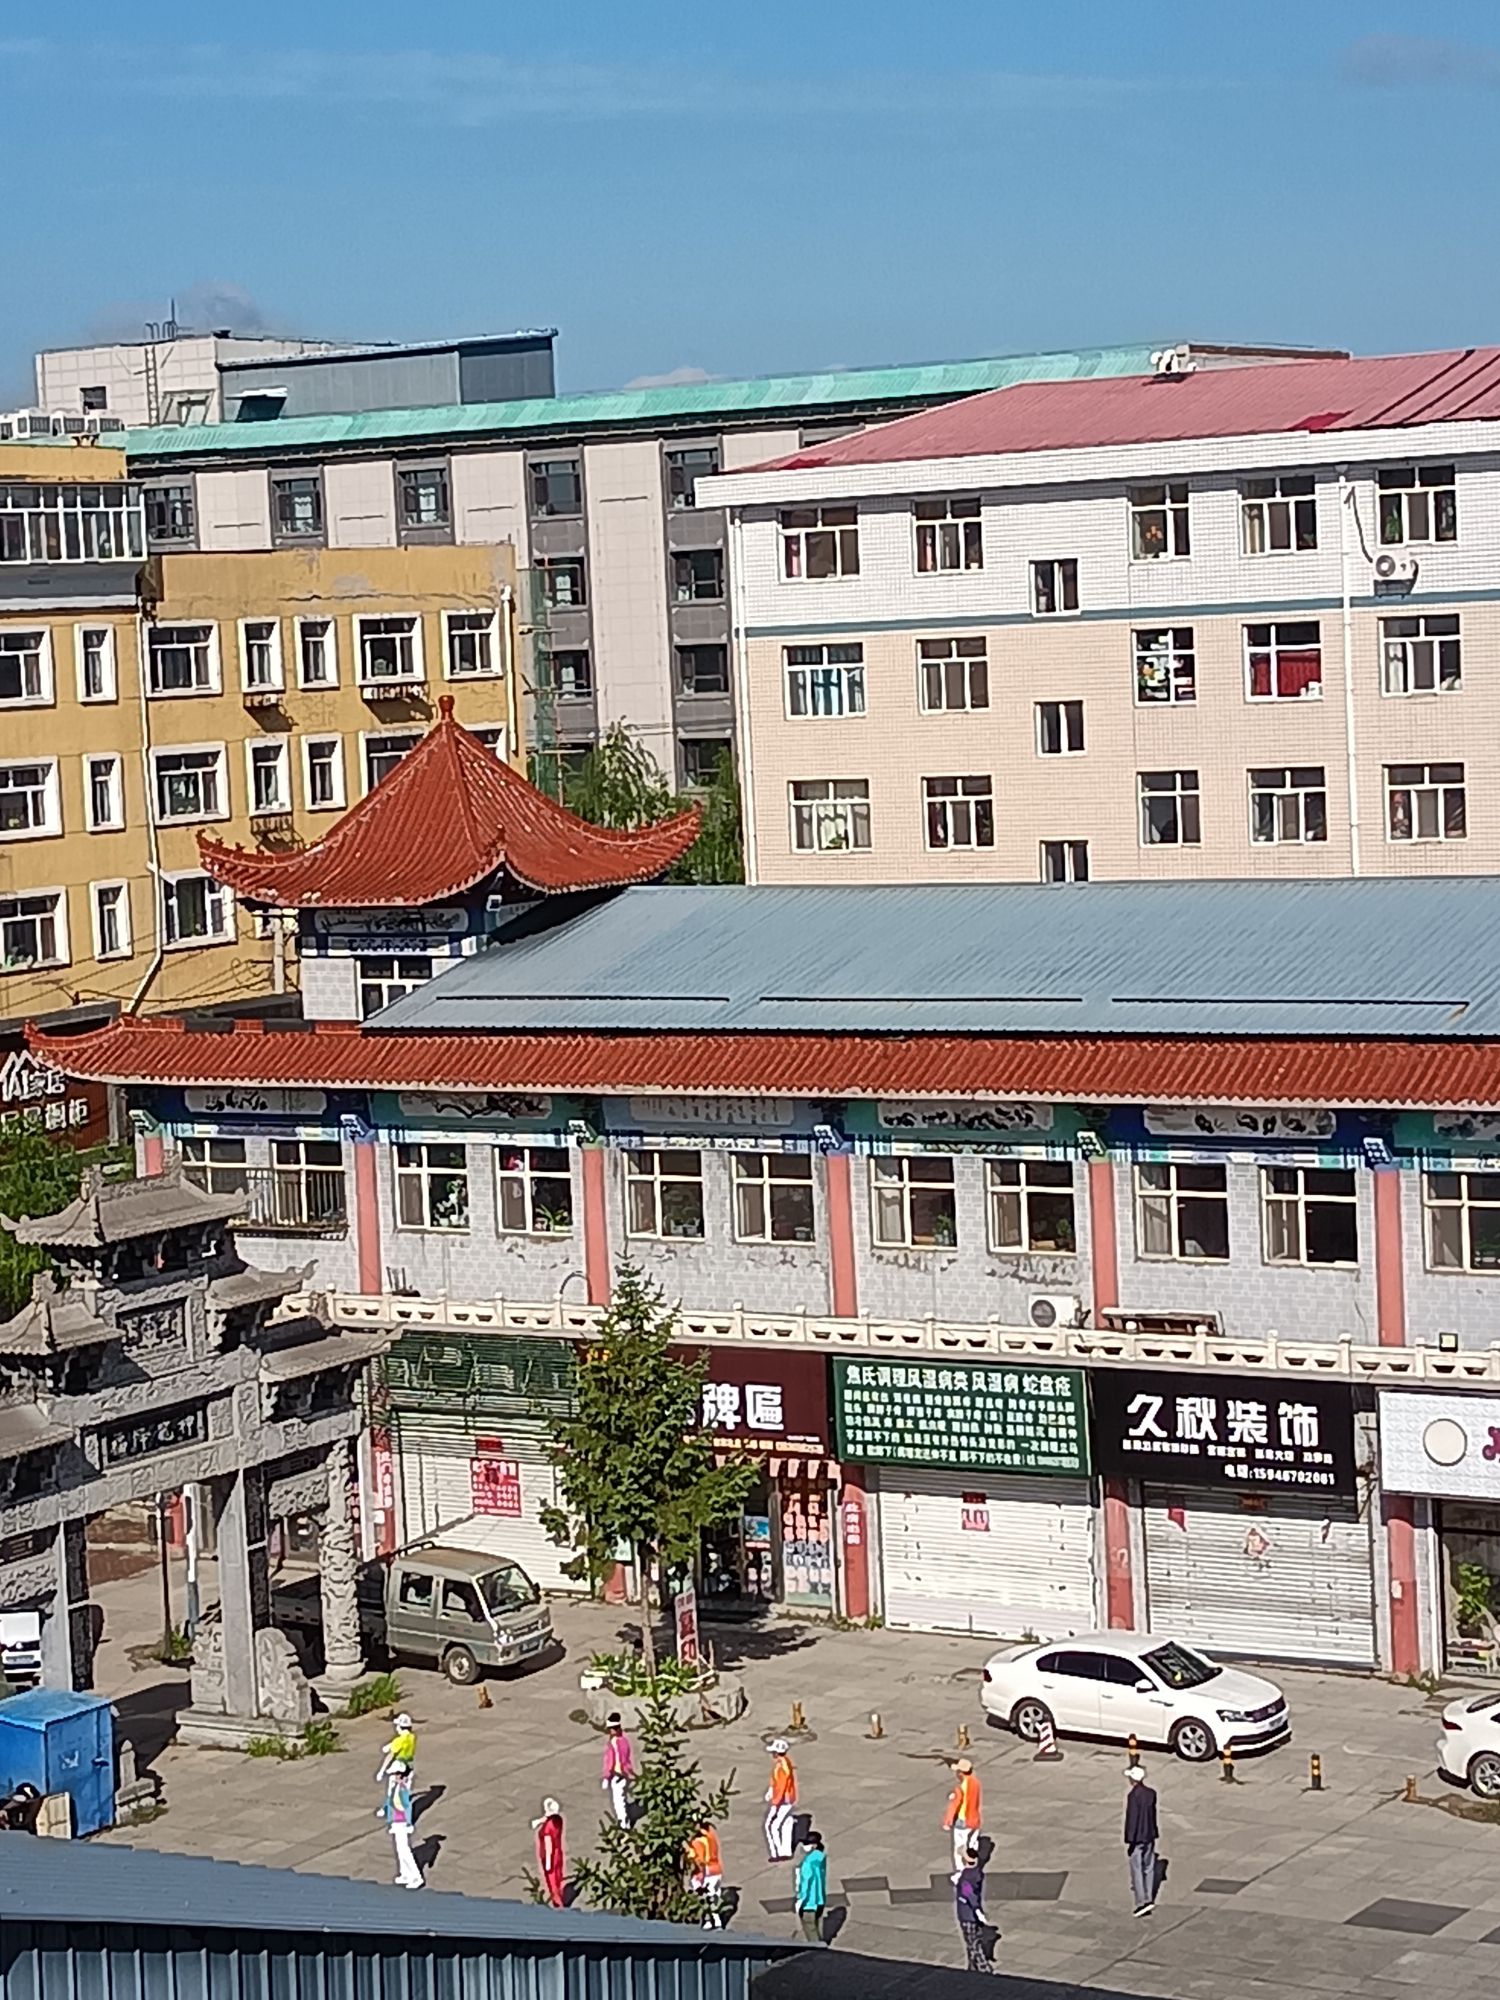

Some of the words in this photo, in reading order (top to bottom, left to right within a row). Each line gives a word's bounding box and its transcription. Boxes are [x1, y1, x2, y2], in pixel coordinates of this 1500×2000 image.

[686, 1382, 785, 1431] 牌匾
[1126, 1393, 1319, 1447] 久秋装饰
